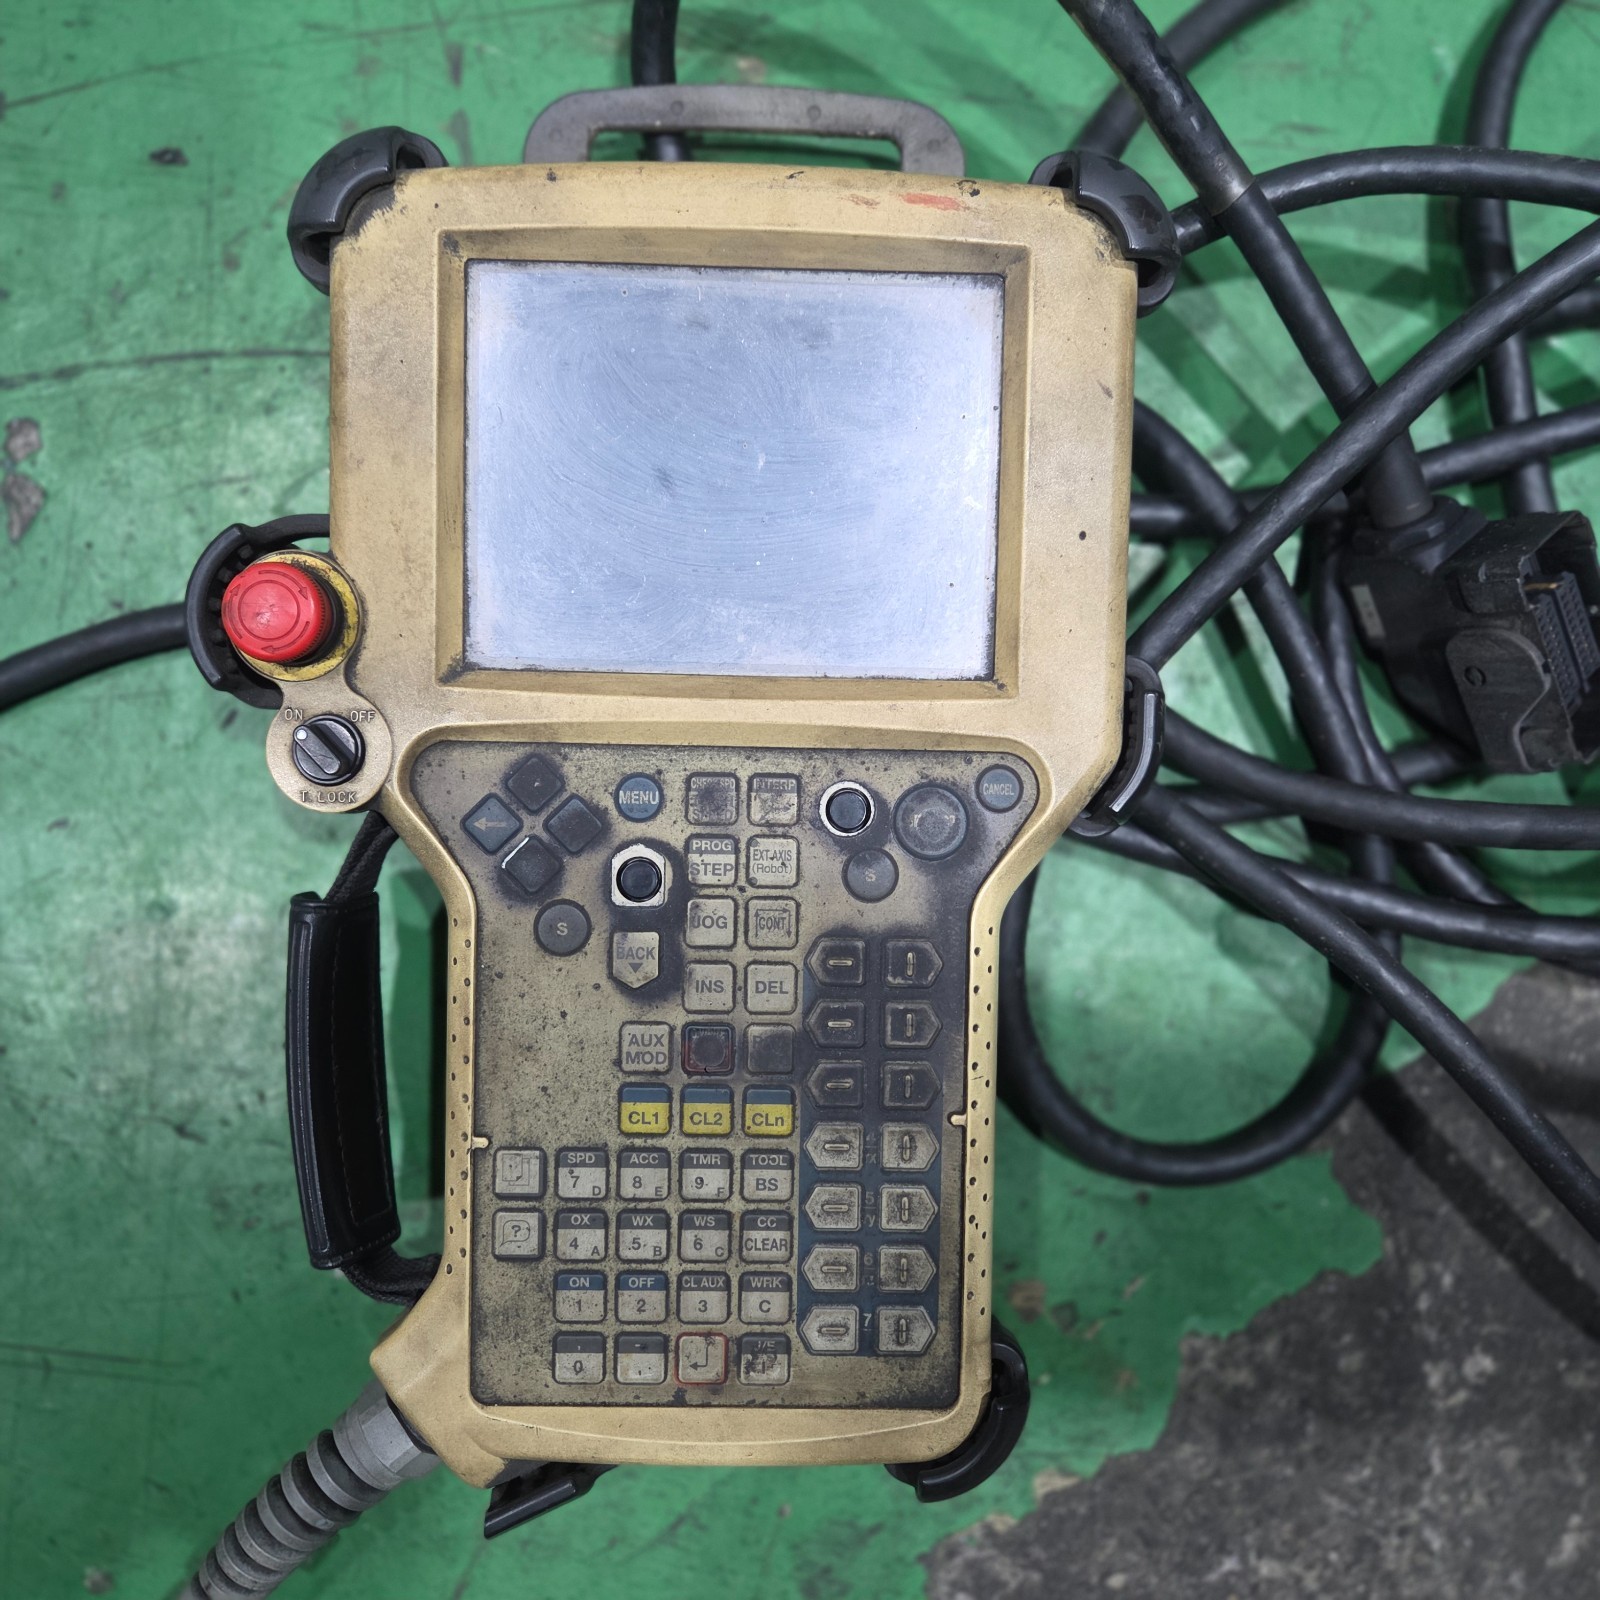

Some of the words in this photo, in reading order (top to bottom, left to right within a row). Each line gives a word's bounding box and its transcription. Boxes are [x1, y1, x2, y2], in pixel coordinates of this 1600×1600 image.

[284, 708, 303, 720] ON
[350, 710, 376, 722] OFF
[983, 783, 1014, 796] CANCEL
[300, 790, 309, 802] T
[317, 791, 357, 803] LOCK
[618, 790, 660, 805] MENU
[692, 840, 732, 851] PROG
[690, 863, 735, 877] STEP
[752, 862, 793, 875] (Robot)
[690, 915, 728, 929] JOG
[758, 917, 787, 931] CONT
[556, 922, 568, 936] S
[616, 946, 656, 961] BACK
[695, 980, 725, 994] INS
[755, 981, 789, 995] DEL
[628, 1033, 665, 1047] AUX
[625, 1051, 667, 1065] MOD
[628, 1111, 660, 1125] CL1
[690, 1112, 723, 1126] CL2
[751, 1112, 785, 1127] CLn
[567, 1152, 596, 1164] SPD
[629, 1153, 659, 1164] ACC
[690, 1154, 721, 1165] TMR
[750, 1155, 787, 1166] TOOL
[570, 1176, 580, 1188] 7
[632, 1176, 642, 1189] 8
[694, 1177, 705, 1189] 9
[755, 1178, 779, 1191] BS
[592, 1185, 602, 1196] D
[654, 1186, 663, 1197] E
[717, 1187, 725, 1197] F
[864, 1191, 875, 1205] 5
[570, 1214, 590, 1225] OX
[631, 1215, 654, 1226] WX
[693, 1216, 716, 1226] WS
[757, 1216, 777, 1227] CC
[569, 1237, 579, 1250] 4
[631, 1237, 641, 1250] 5
[693, 1238, 704, 1251] 6
[744, 1238, 788, 1251] CLEAR
[590, 1246, 600, 1256] A
[653, 1246, 662, 1257] B
[714, 1247, 724, 1258] C
[863, 1252, 873, 1266] 6
[569, 1277, 590, 1288] ON
[628, 1277, 655, 1288] OFF
[751, 1277, 782, 1288] WRK
[636, 1299, 646, 1313] 2
[698, 1300, 708, 1313] 3
[758, 1300, 771, 1313] C
[863, 1312, 873, 1327] 7
[573, 1360, 583, 1374] 0
